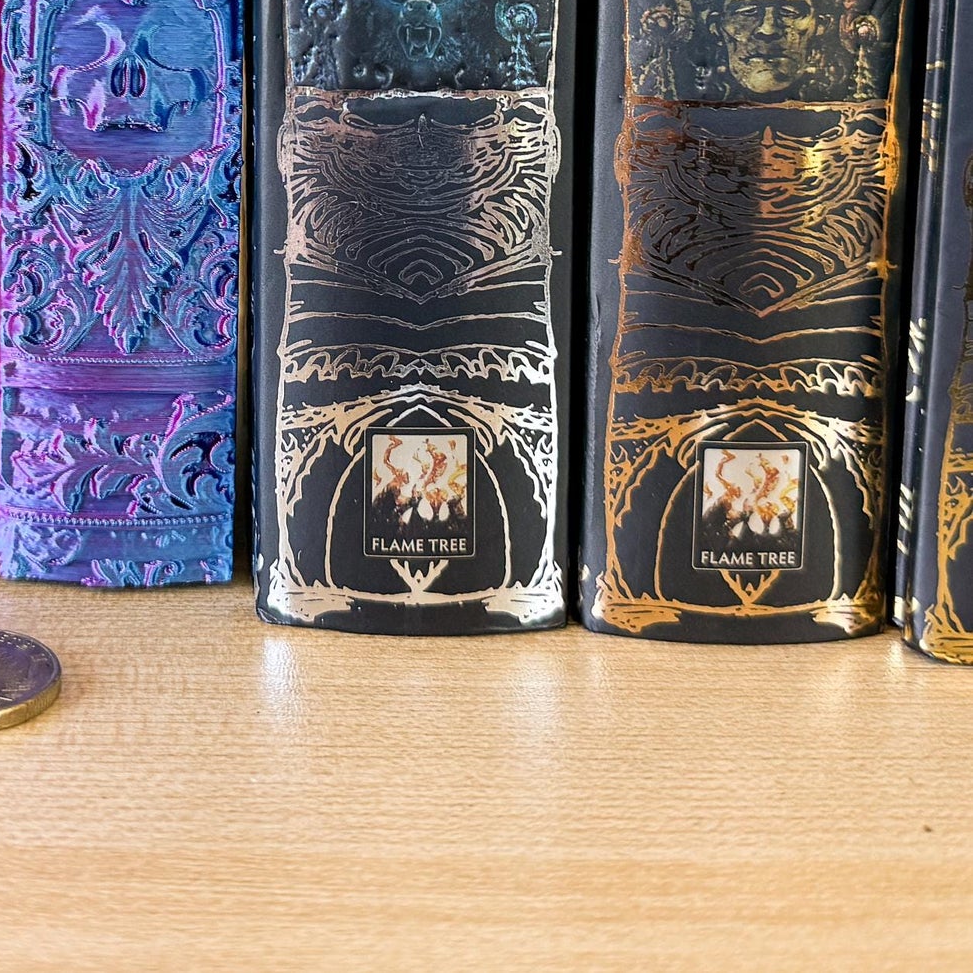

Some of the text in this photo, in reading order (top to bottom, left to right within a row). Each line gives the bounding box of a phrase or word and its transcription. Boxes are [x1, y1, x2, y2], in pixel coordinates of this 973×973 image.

[372, 538, 467, 552] FLAME TREE
[701, 551, 796, 565] FLAME TREE
